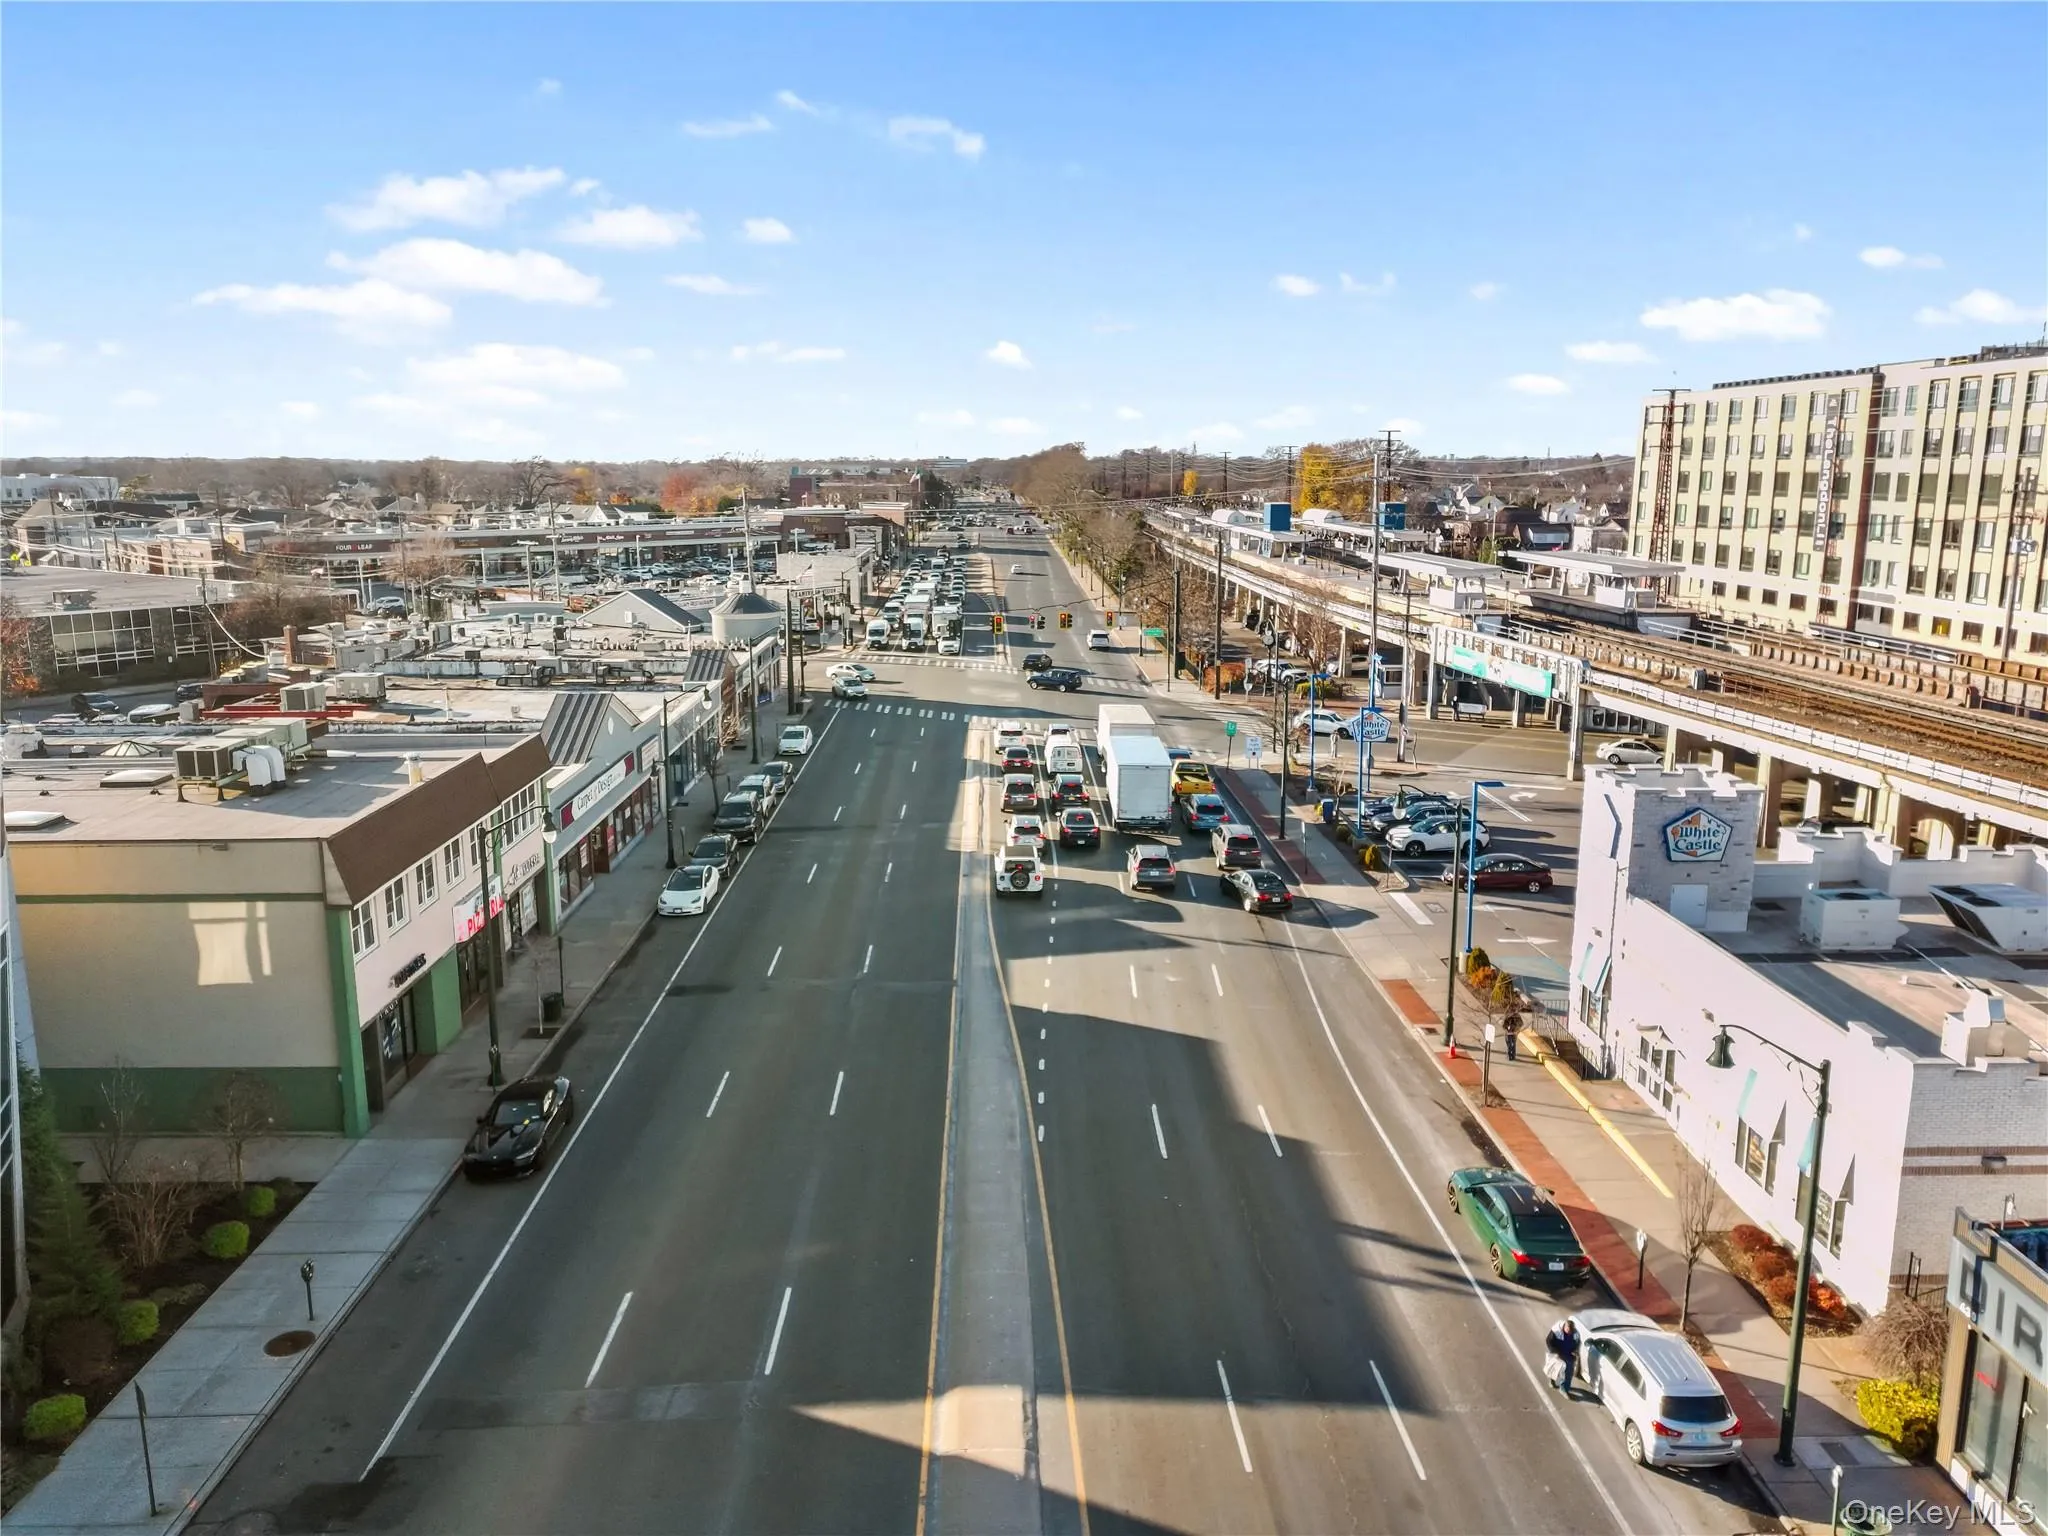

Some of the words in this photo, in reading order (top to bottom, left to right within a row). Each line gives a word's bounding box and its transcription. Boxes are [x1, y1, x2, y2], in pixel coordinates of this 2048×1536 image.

[1678, 826, 1720, 840] White
[1674, 838, 1721, 851] Castle
[467, 895, 505, 937] PIZRIA
